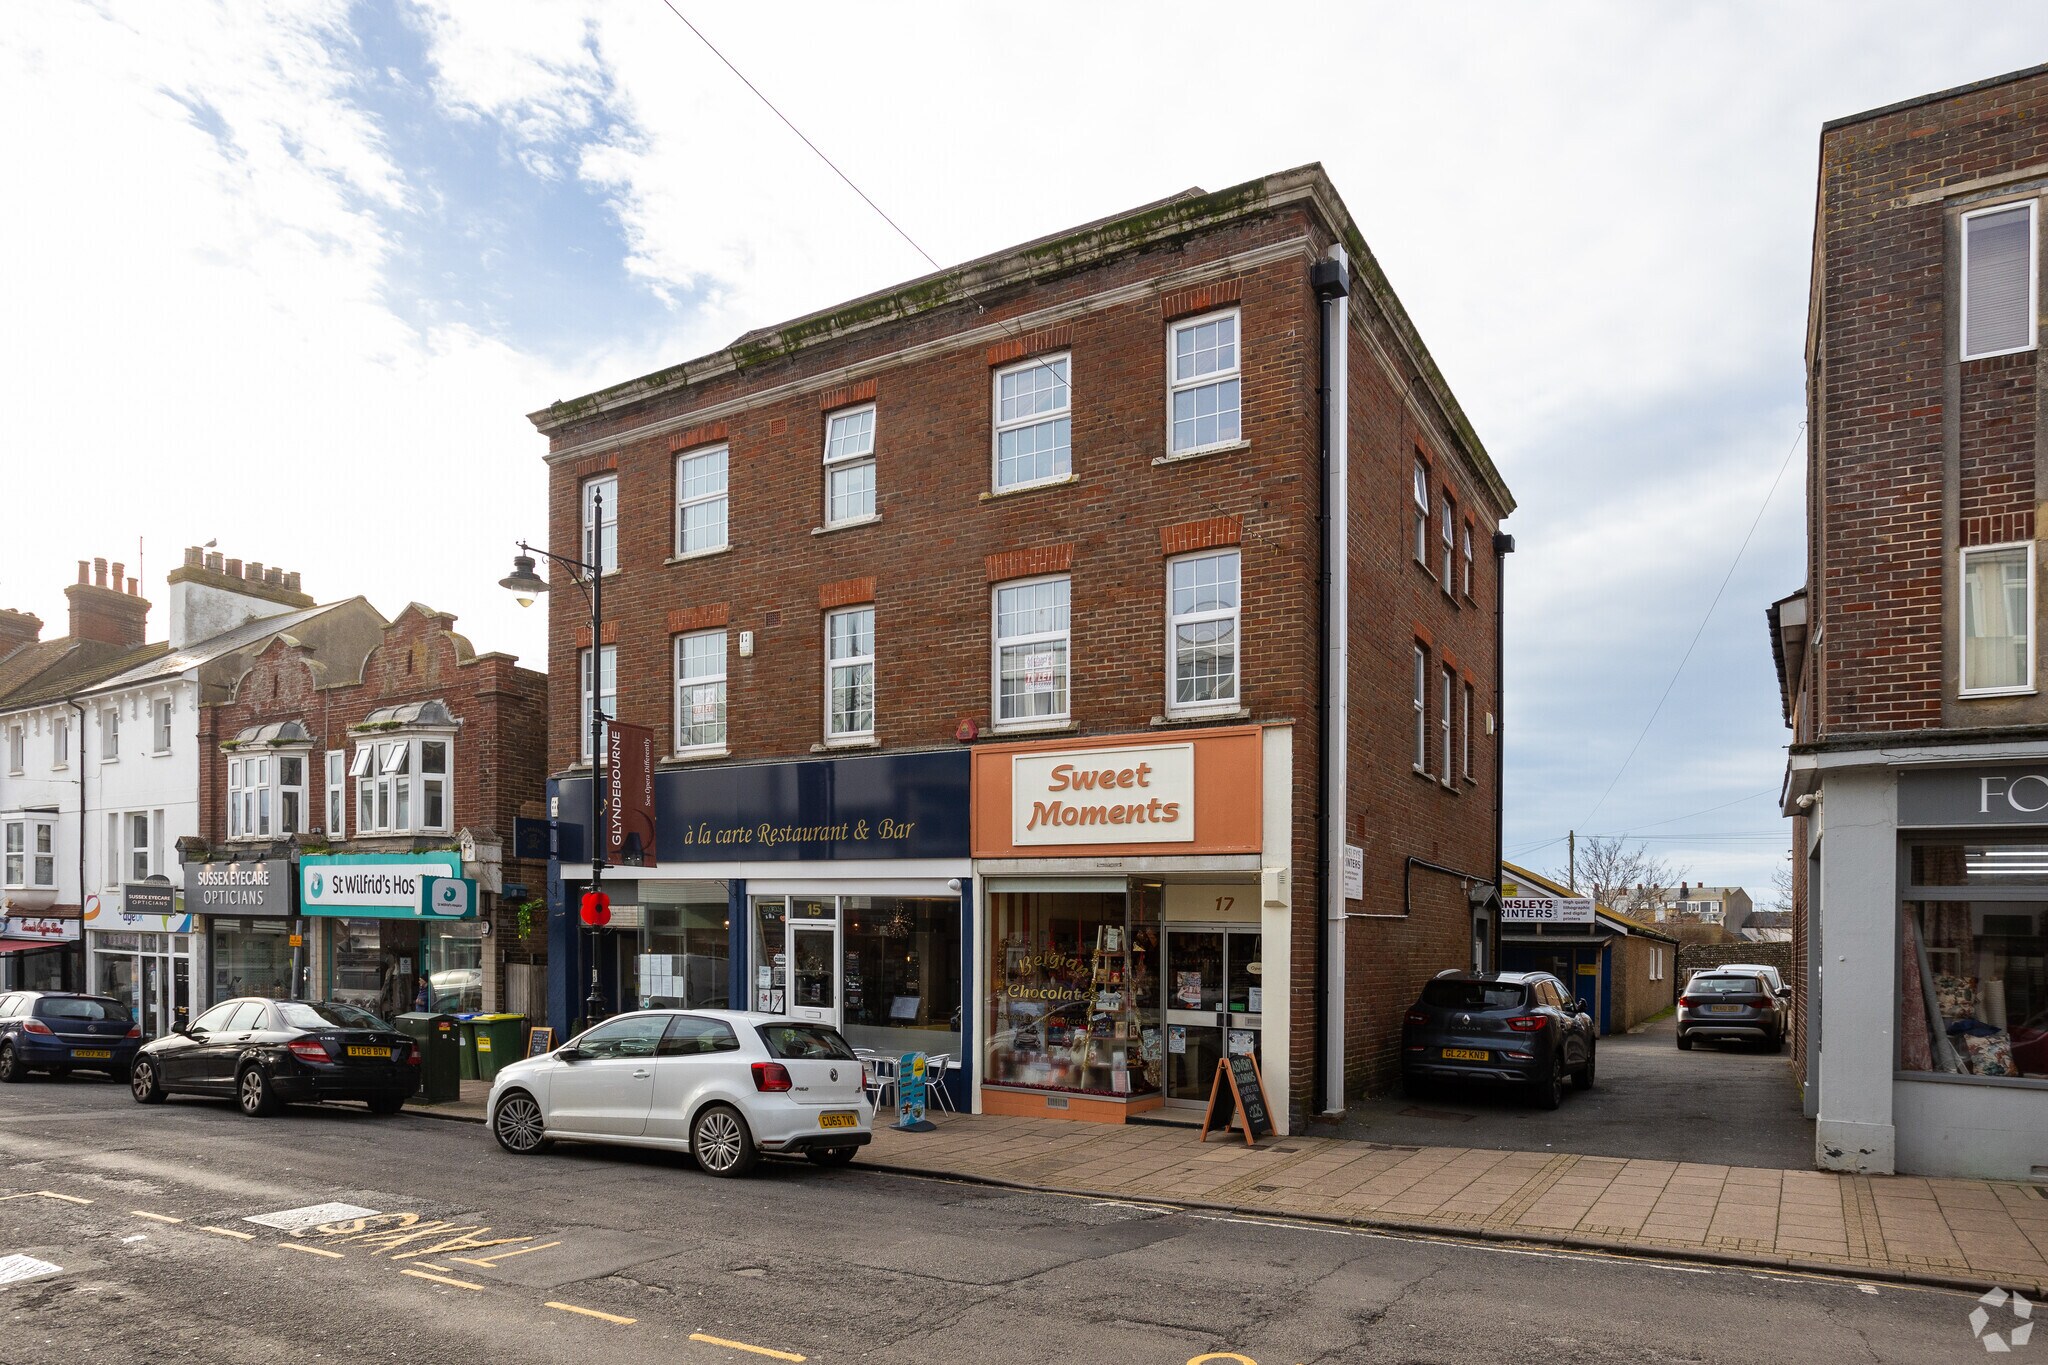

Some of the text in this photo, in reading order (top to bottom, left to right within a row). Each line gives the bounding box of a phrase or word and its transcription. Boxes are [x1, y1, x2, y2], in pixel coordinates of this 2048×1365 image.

[644, 737, 652, 773] Differently
[1048, 762, 1152, 792] Sweet
[611, 731, 622, 846] GLYNDEBOURNE
[1026, 798, 1180, 831] Moments
[684, 818, 916, 847] à la carte Restaurant & Bar
[198, 870, 269, 886] SUSSEX EYECARE
[332, 875, 343, 894] St
[345, 874, 390, 895] Wilfrid's
[203, 890, 264, 905] OPTICIANS
[1215, 896, 1235, 911] 17
[1501, 900, 1553, 909] NSLEYS
[807, 903, 822, 916] 15
[1019, 951, 1089, 977] Belgian
[1007, 984, 1099, 1002] Chocolates
[351, 1047, 372, 1055] BT08
[1445, 1049, 1486, 1060] GL22 KNB
[822, 1115, 842, 1127] CU65
